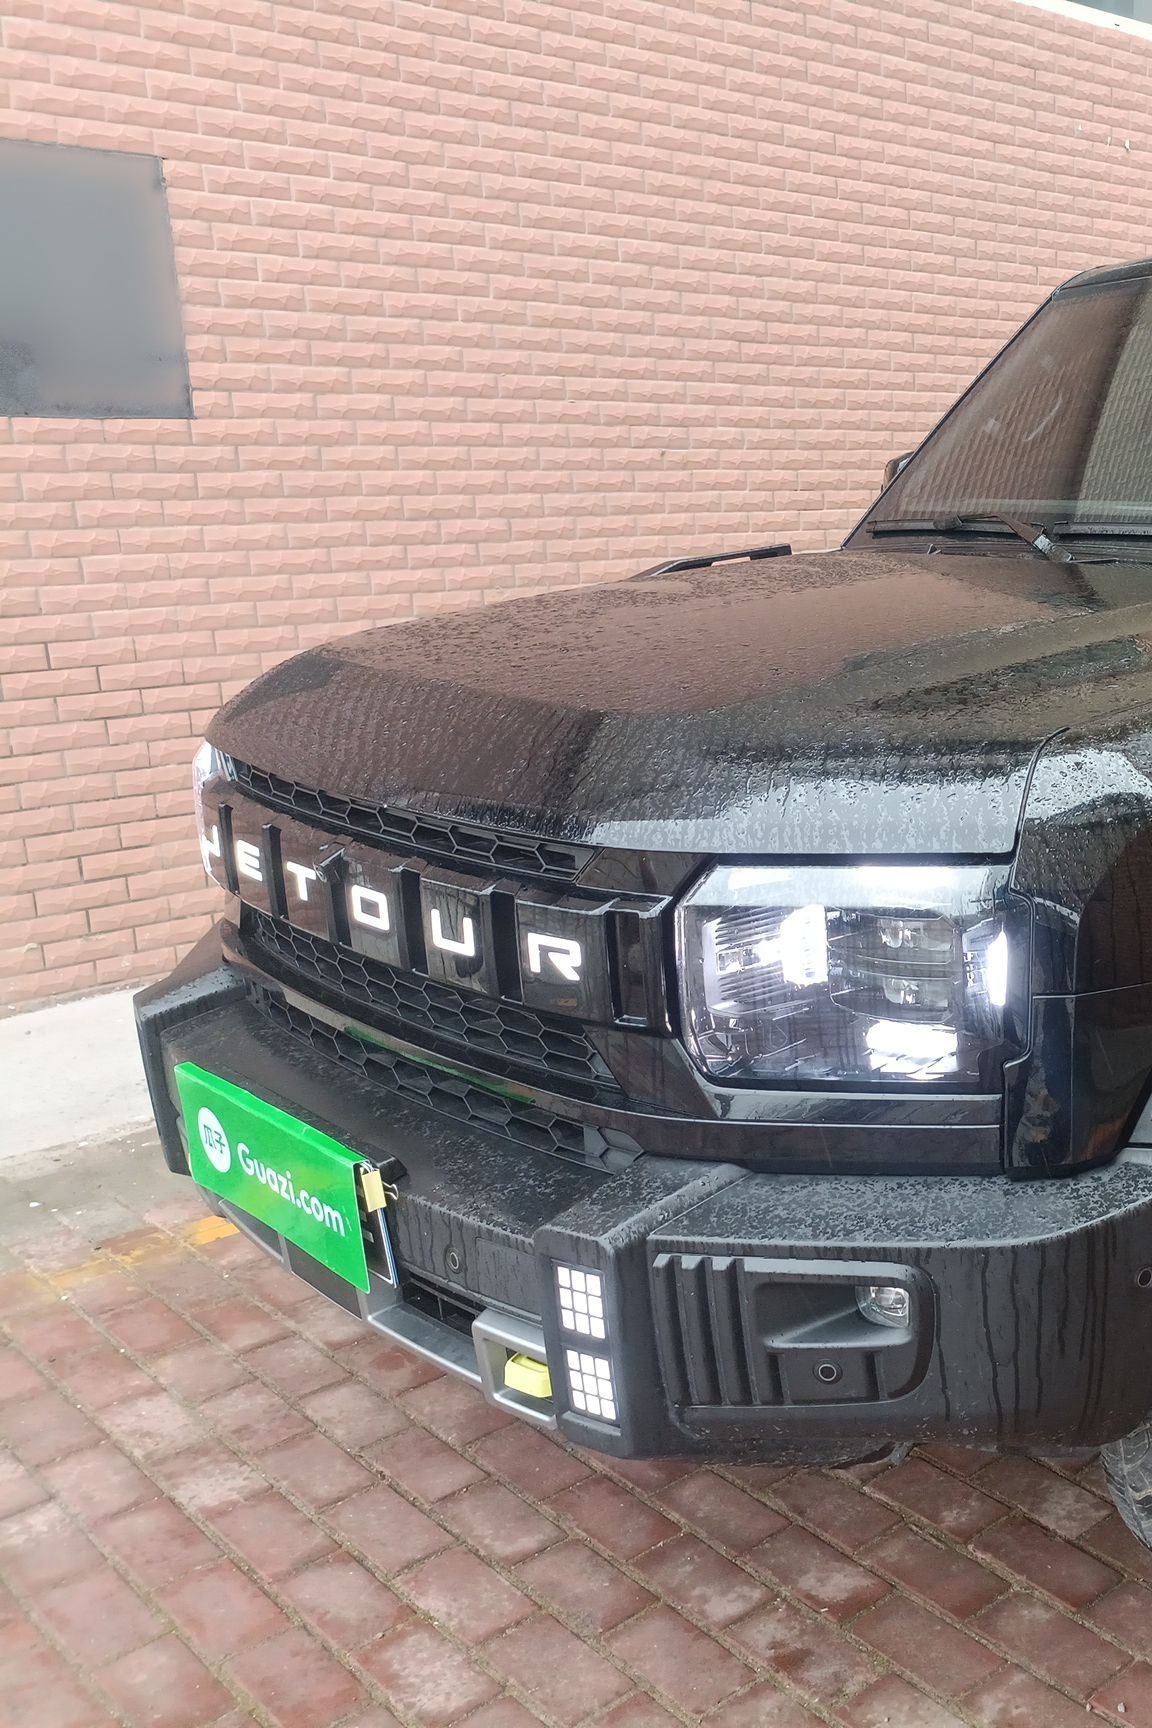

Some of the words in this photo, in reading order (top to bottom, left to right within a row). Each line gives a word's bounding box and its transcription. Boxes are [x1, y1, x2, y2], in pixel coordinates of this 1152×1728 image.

[202, 824, 582, 981] JETOUR
[203, 1124, 226, 1154] 瓜子
[237, 1142, 346, 1238] Guazi.com
